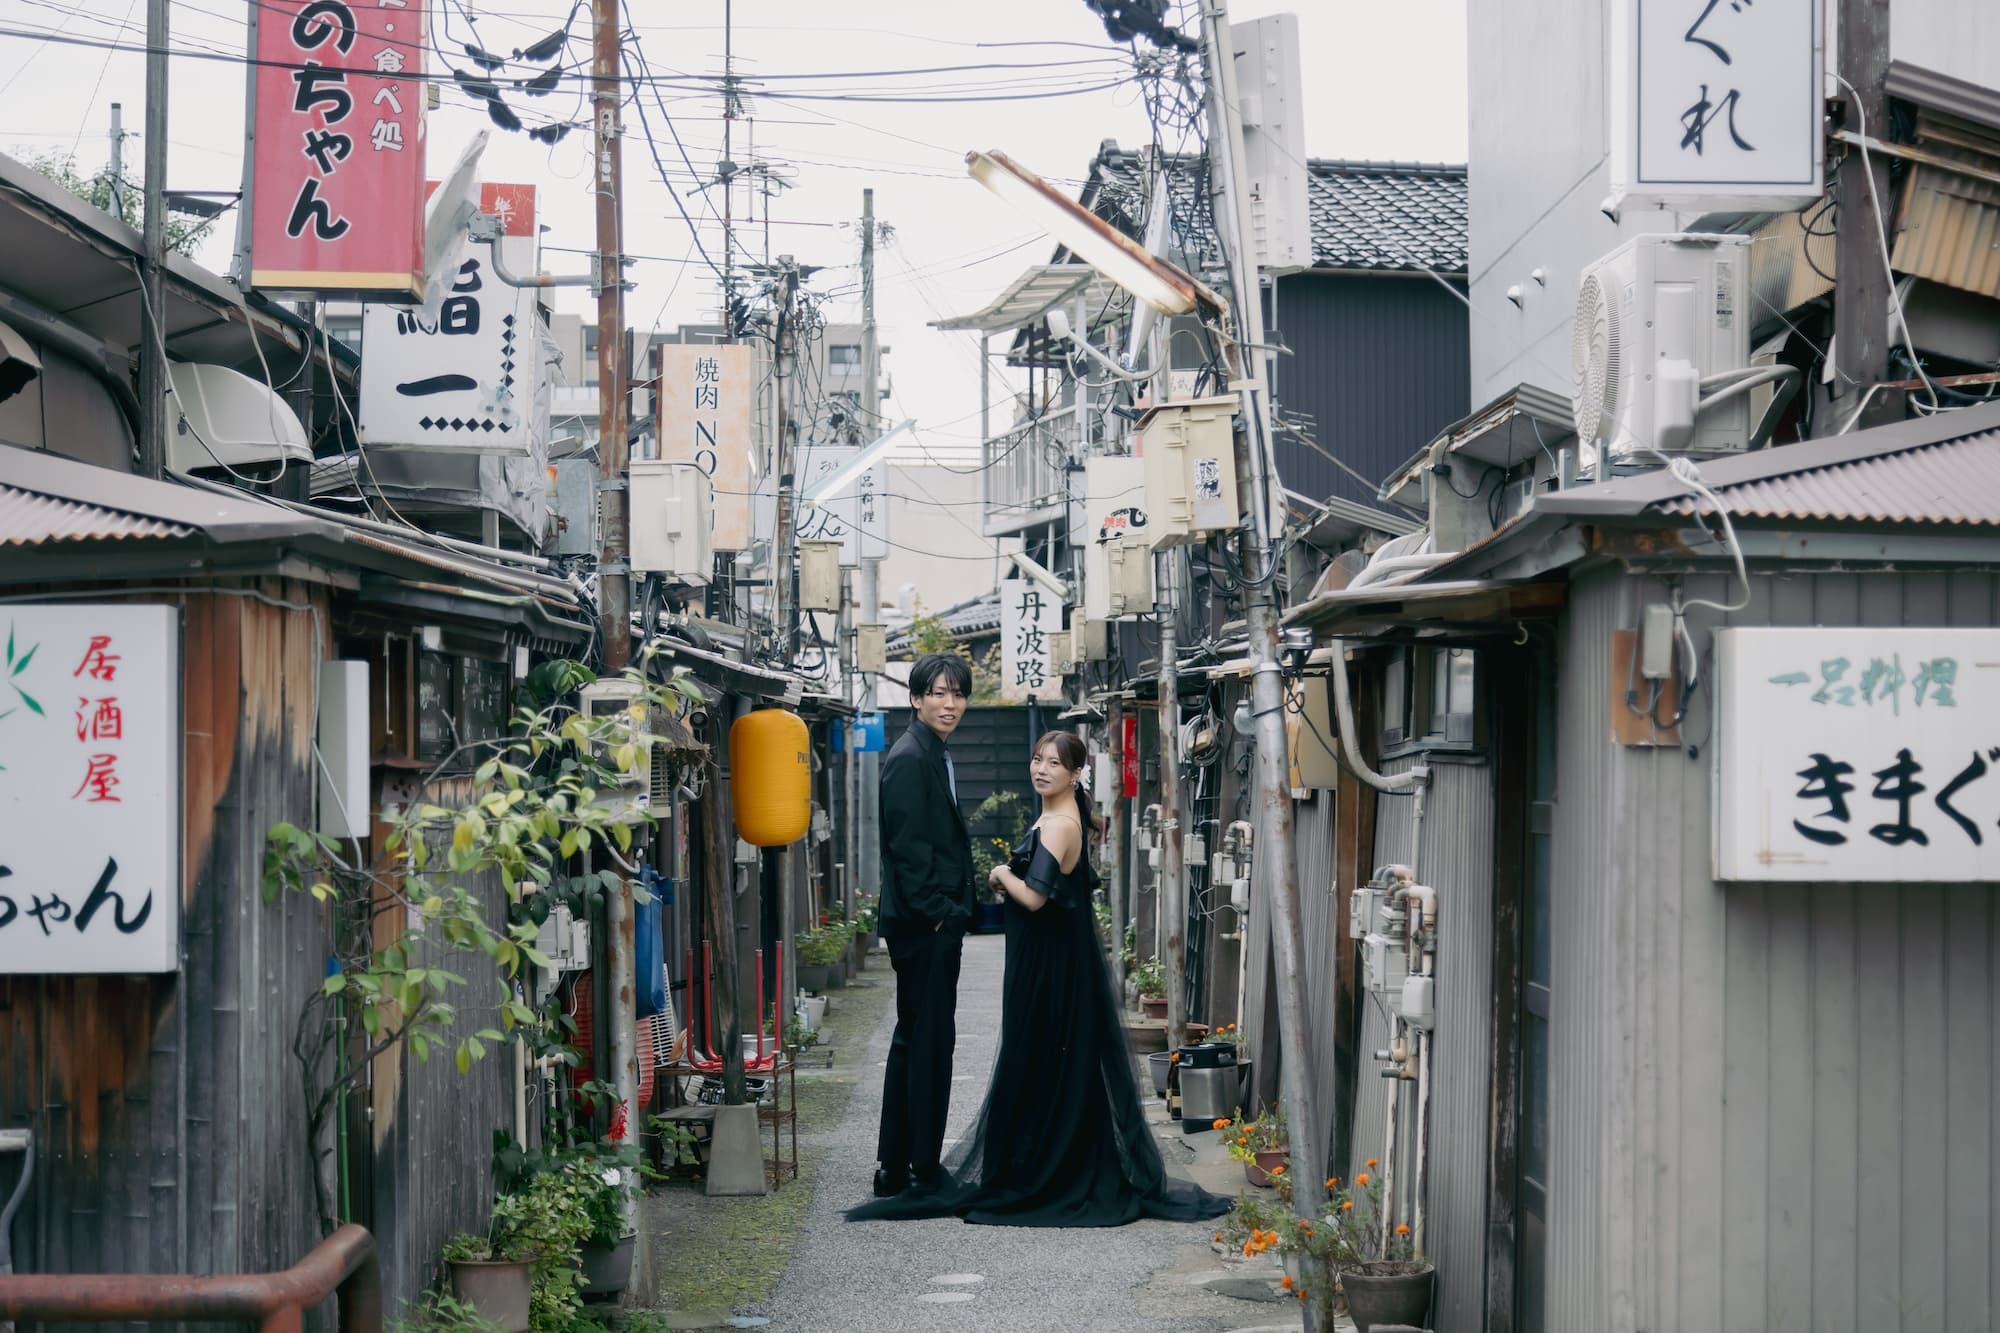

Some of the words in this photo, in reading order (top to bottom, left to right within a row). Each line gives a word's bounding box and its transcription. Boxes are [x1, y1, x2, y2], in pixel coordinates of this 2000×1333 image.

[287, 0, 358, 241] のちゃん
[371, 0, 408, 152] ・食べ処
[695, 356, 719, 410] 焼肉
[1016, 591, 1047, 688] 丹波路
[1768, 652, 1958, 716] 一品料理
[72, 635, 123, 803] 居酒屋
[1793, 747, 2000, 846] きまぐ
